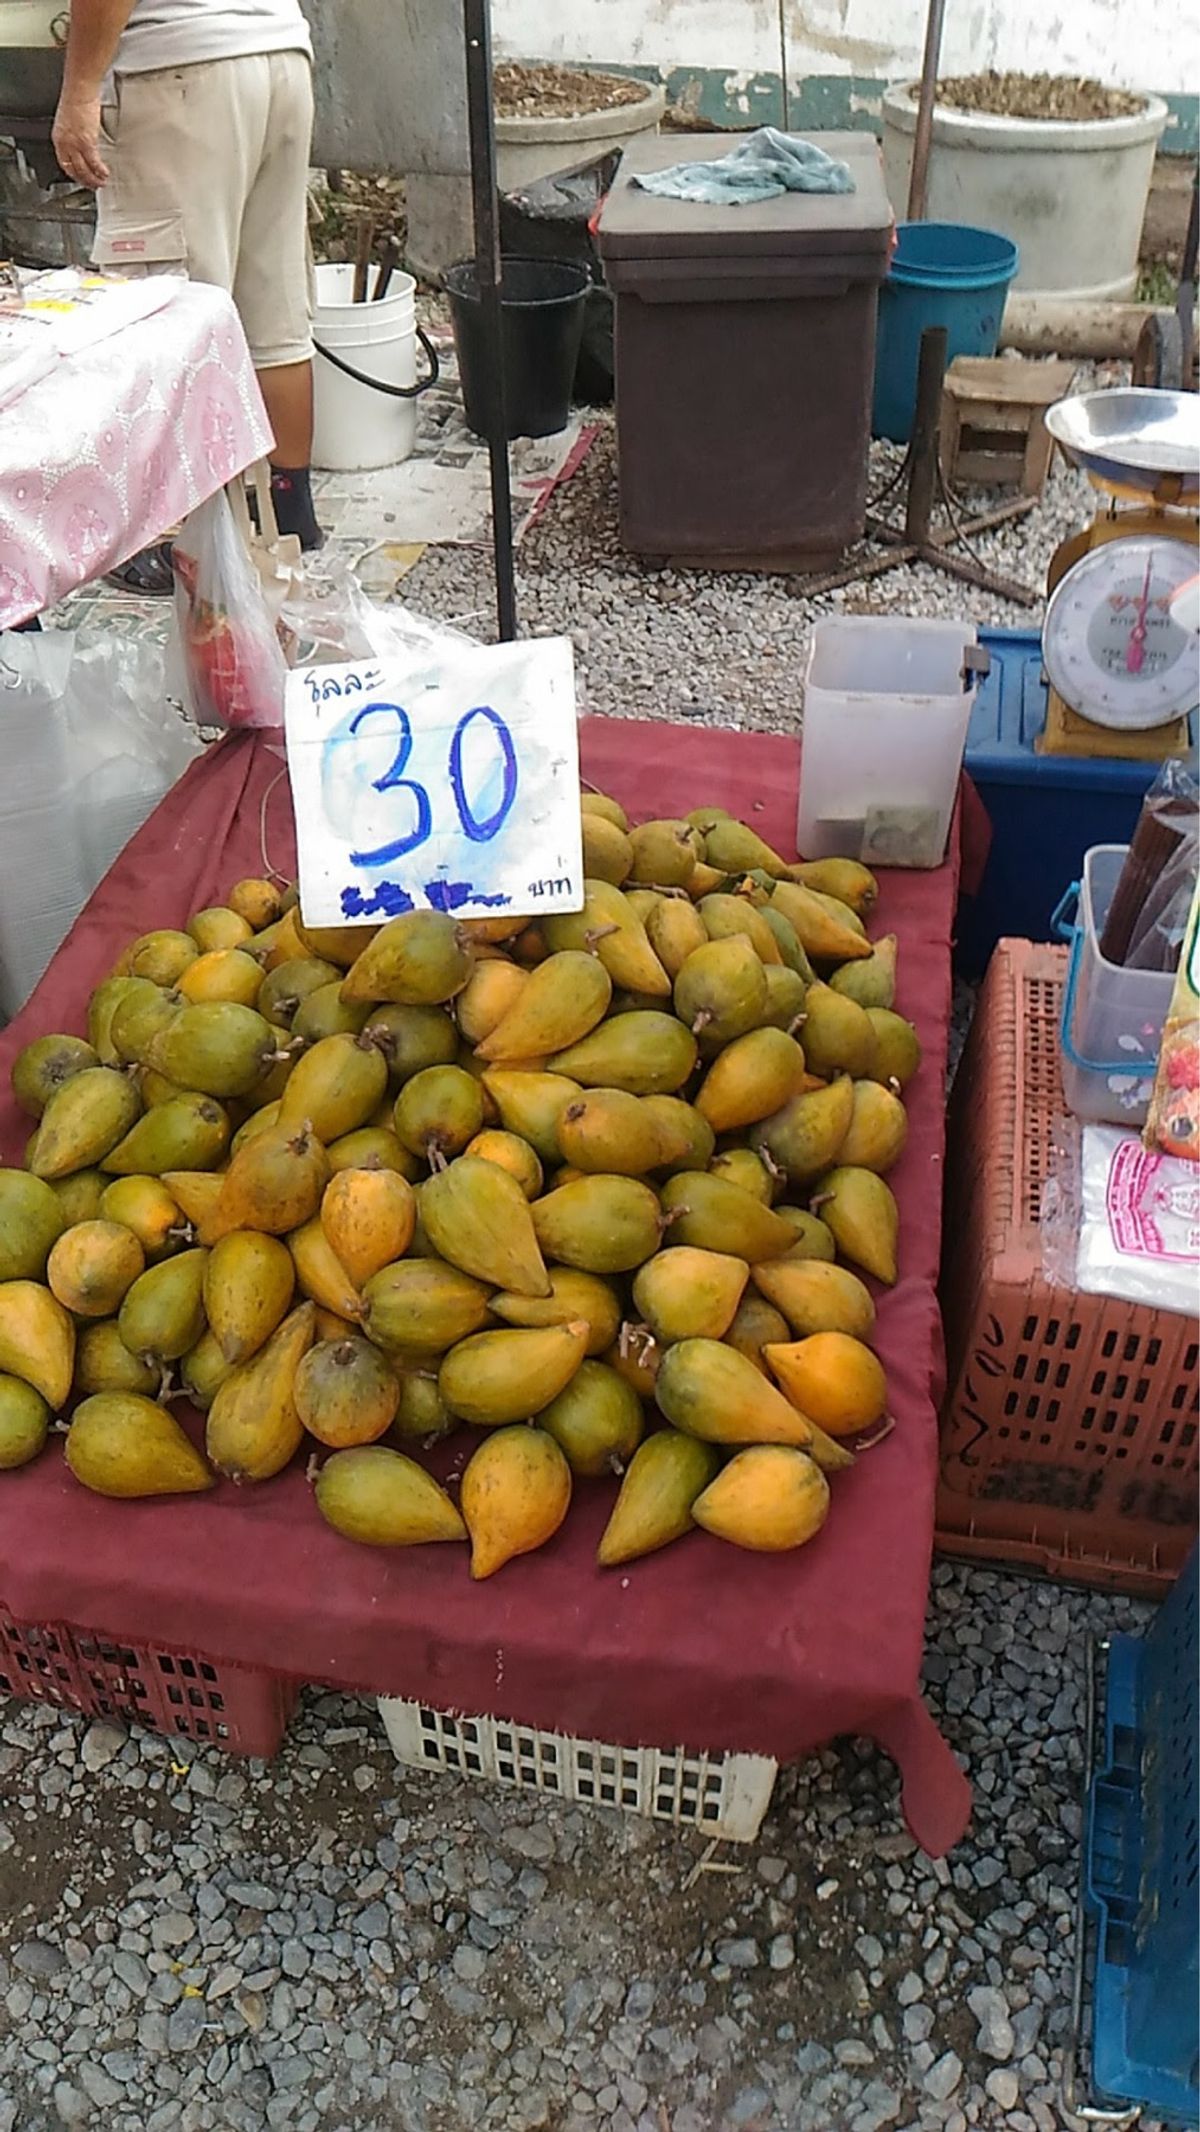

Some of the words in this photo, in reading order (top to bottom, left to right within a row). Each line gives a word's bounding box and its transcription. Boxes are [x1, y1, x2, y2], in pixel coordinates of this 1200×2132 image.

[304, 669, 386, 703] โลละ
[349, 702, 518, 868] 30
[528, 877, 573, 897] บาท
